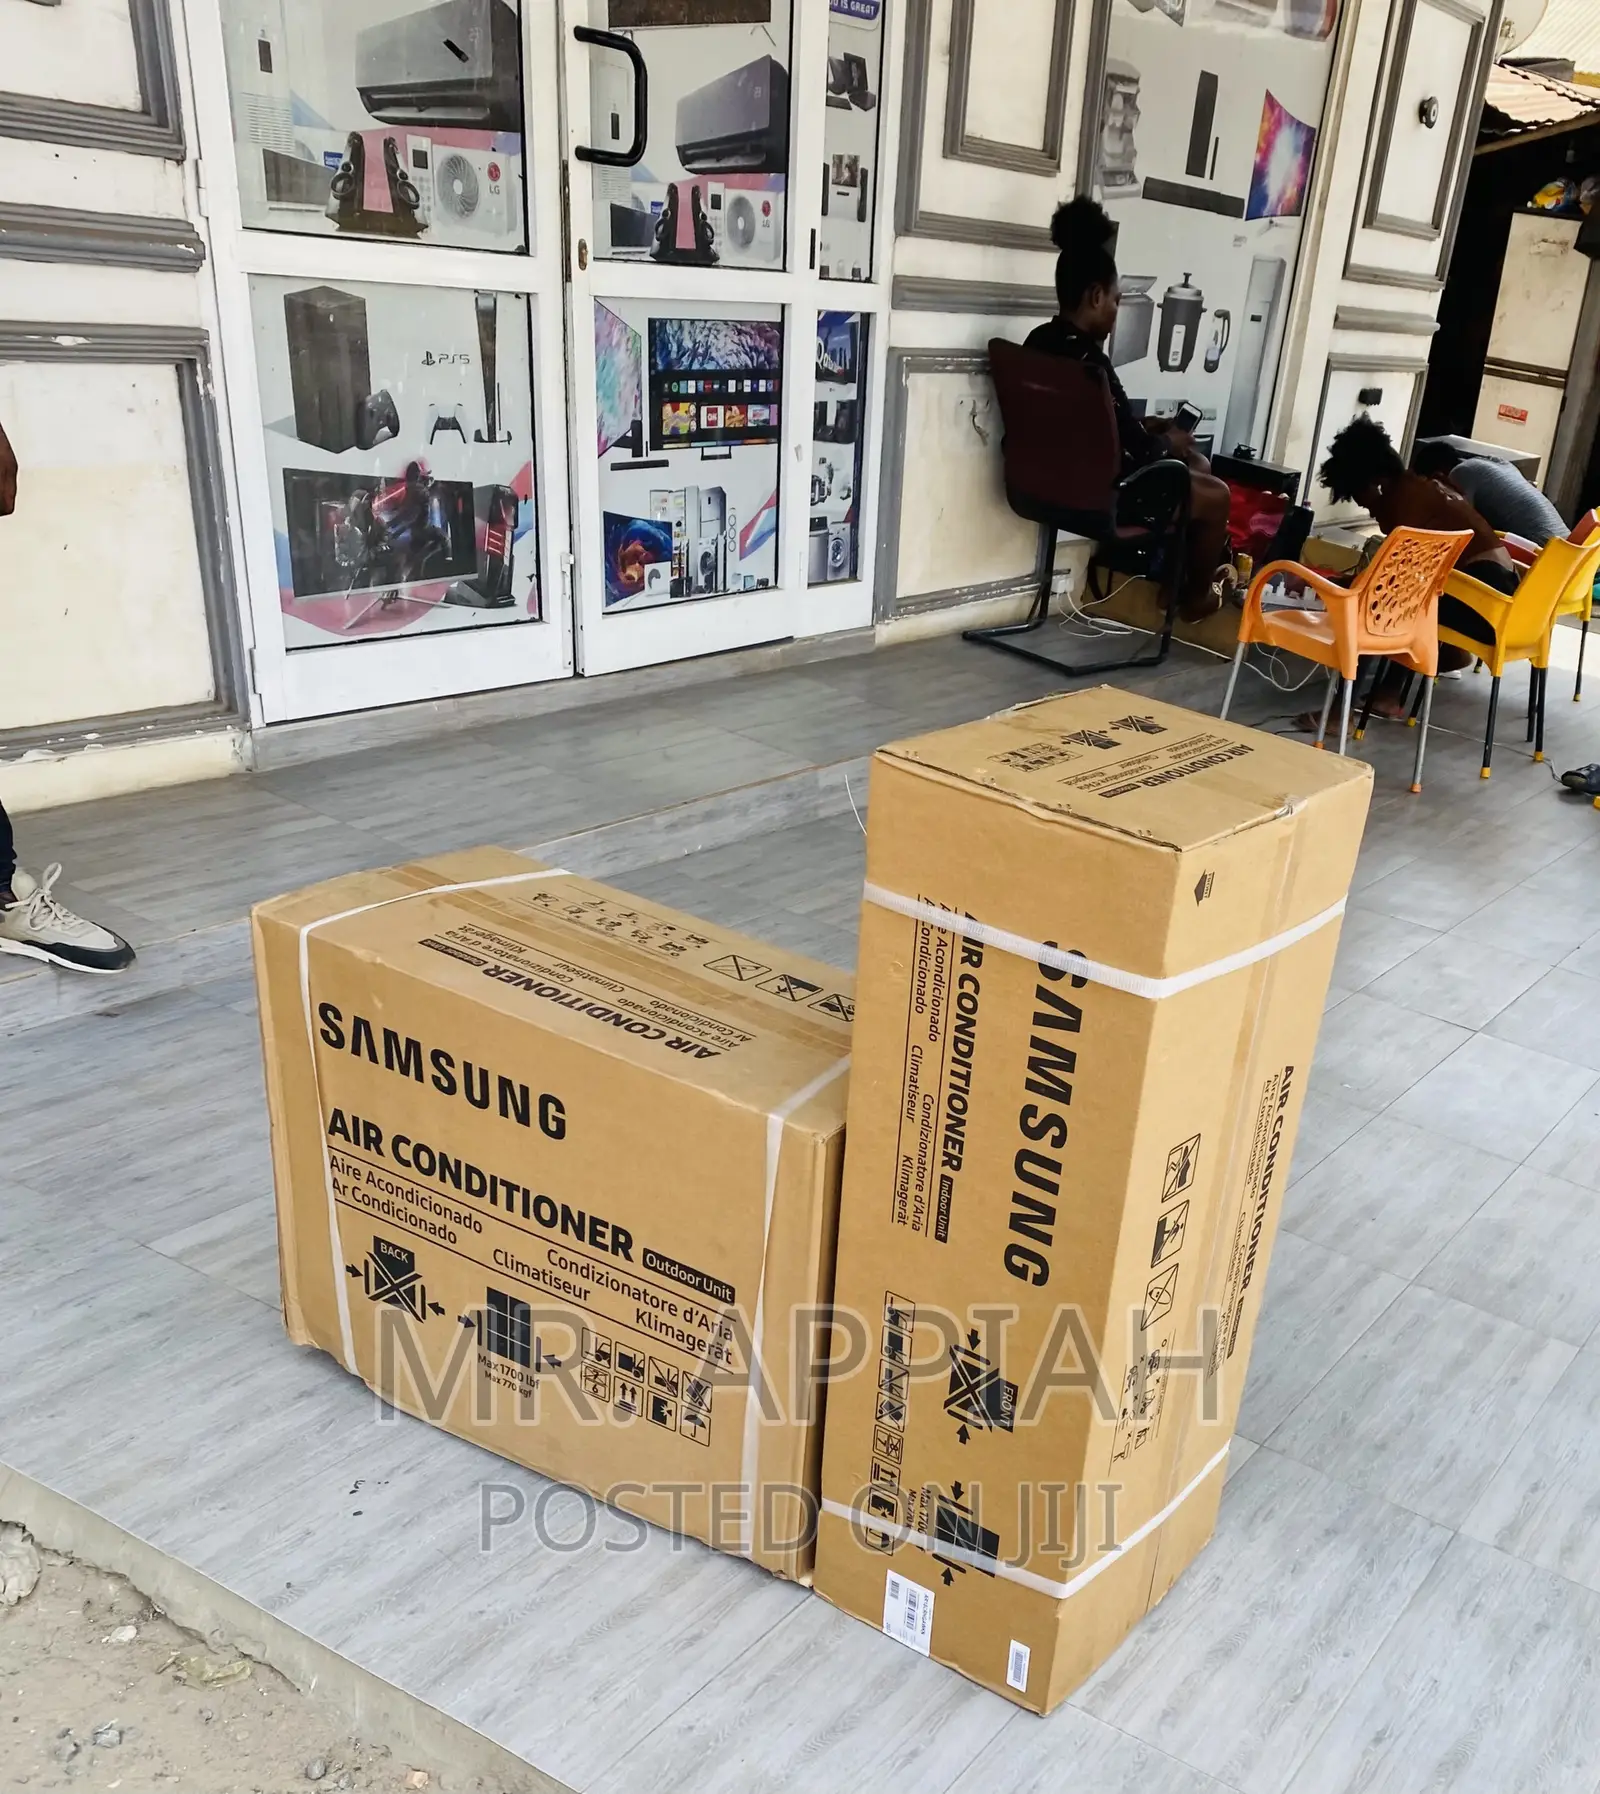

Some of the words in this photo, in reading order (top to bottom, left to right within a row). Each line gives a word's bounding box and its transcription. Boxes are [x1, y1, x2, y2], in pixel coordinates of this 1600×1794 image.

[850, 1, 875, 15] GREAT
[489, 184, 500, 195] LG
[438, 353, 470, 364] PS5
[1136, 753, 1234, 787] CONDITIONER
[482, 964, 667, 1040] CONDITIONER
[928, 936, 948, 1042] Acondicionado
[617, 998, 712, 1037] Acondicionado
[711, 1034, 740, 1048] Aire
[318, 1002, 567, 1141] SAMSUNG
[664, 1036, 722, 1059] AIR
[941, 972, 981, 1172] CONDITIONER
[906, 1044, 923, 1123] Climatiseur
[1276, 1066, 1294, 1113] AIR
[915, 1094, 934, 1192] Condizionatore
[328, 1108, 386, 1157] AIR
[391, 1134, 634, 1262] CONDITIONER
[330, 1155, 362, 1180] Aire
[365, 1170, 483, 1234] Acondicionado
[897, 1155, 913, 1226] Klimagerät
[939, 1179, 952, 1214] Indoor
[1240, 1115, 1283, 1294] CONDITIONER
[332, 1176, 348, 1196] Ar
[351, 1186, 457, 1244] Condicionado
[937, 1214, 948, 1238] Unit
[380, 1242, 409, 1264] BACK
[493, 1248, 591, 1301] Climatiseur
[646, 1253, 702, 1287] Outdoor
[703, 1279, 732, 1302] Unit
[547, 1249, 678, 1316] Condizionatore
[683, 1308, 733, 1341] d'Aria
[636, 1308, 732, 1365] Klimagerät
[477, 1353, 498, 1372] Max
[500, 1363, 524, 1383] 1700
[484, 1370, 501, 1385] Max
[502, 1378, 517, 1392] 770
[1000, 1385, 1014, 1427] FRONT
